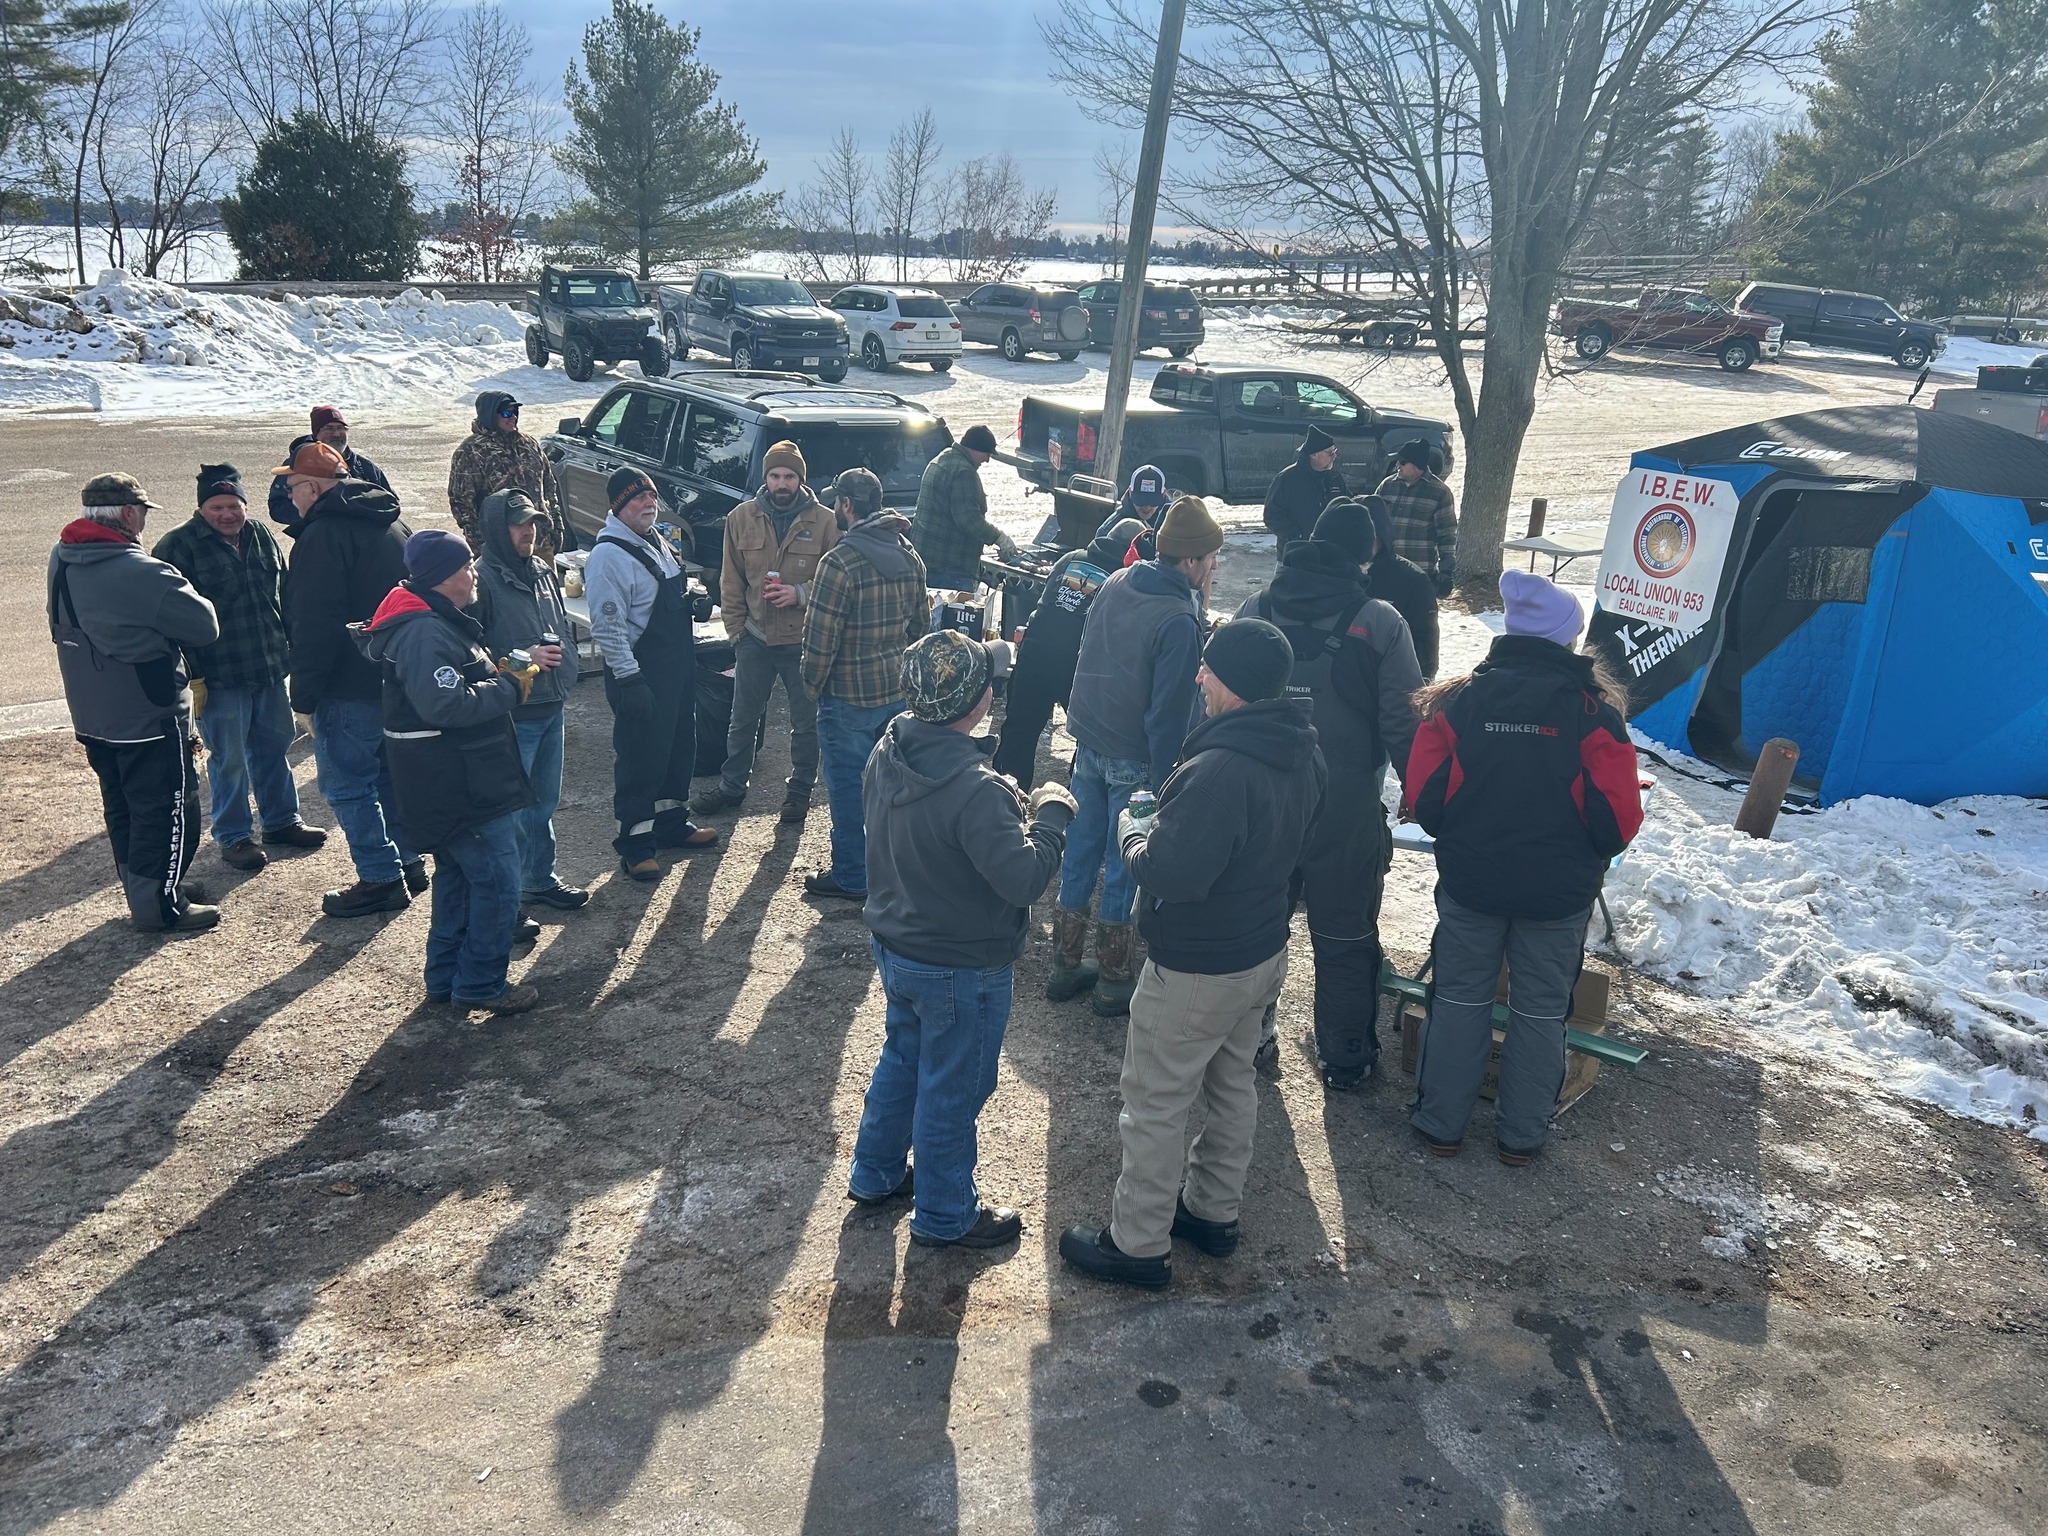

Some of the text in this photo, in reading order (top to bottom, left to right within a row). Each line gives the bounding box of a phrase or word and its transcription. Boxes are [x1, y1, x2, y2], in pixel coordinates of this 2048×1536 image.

[1639, 473, 1715, 507] I.B.E.W.
[1604, 572, 1705, 612] LOCAL UNION 953
[955, 610, 976, 624] Lite
[1618, 598, 1679, 624] EAU CLAIRE, WI
